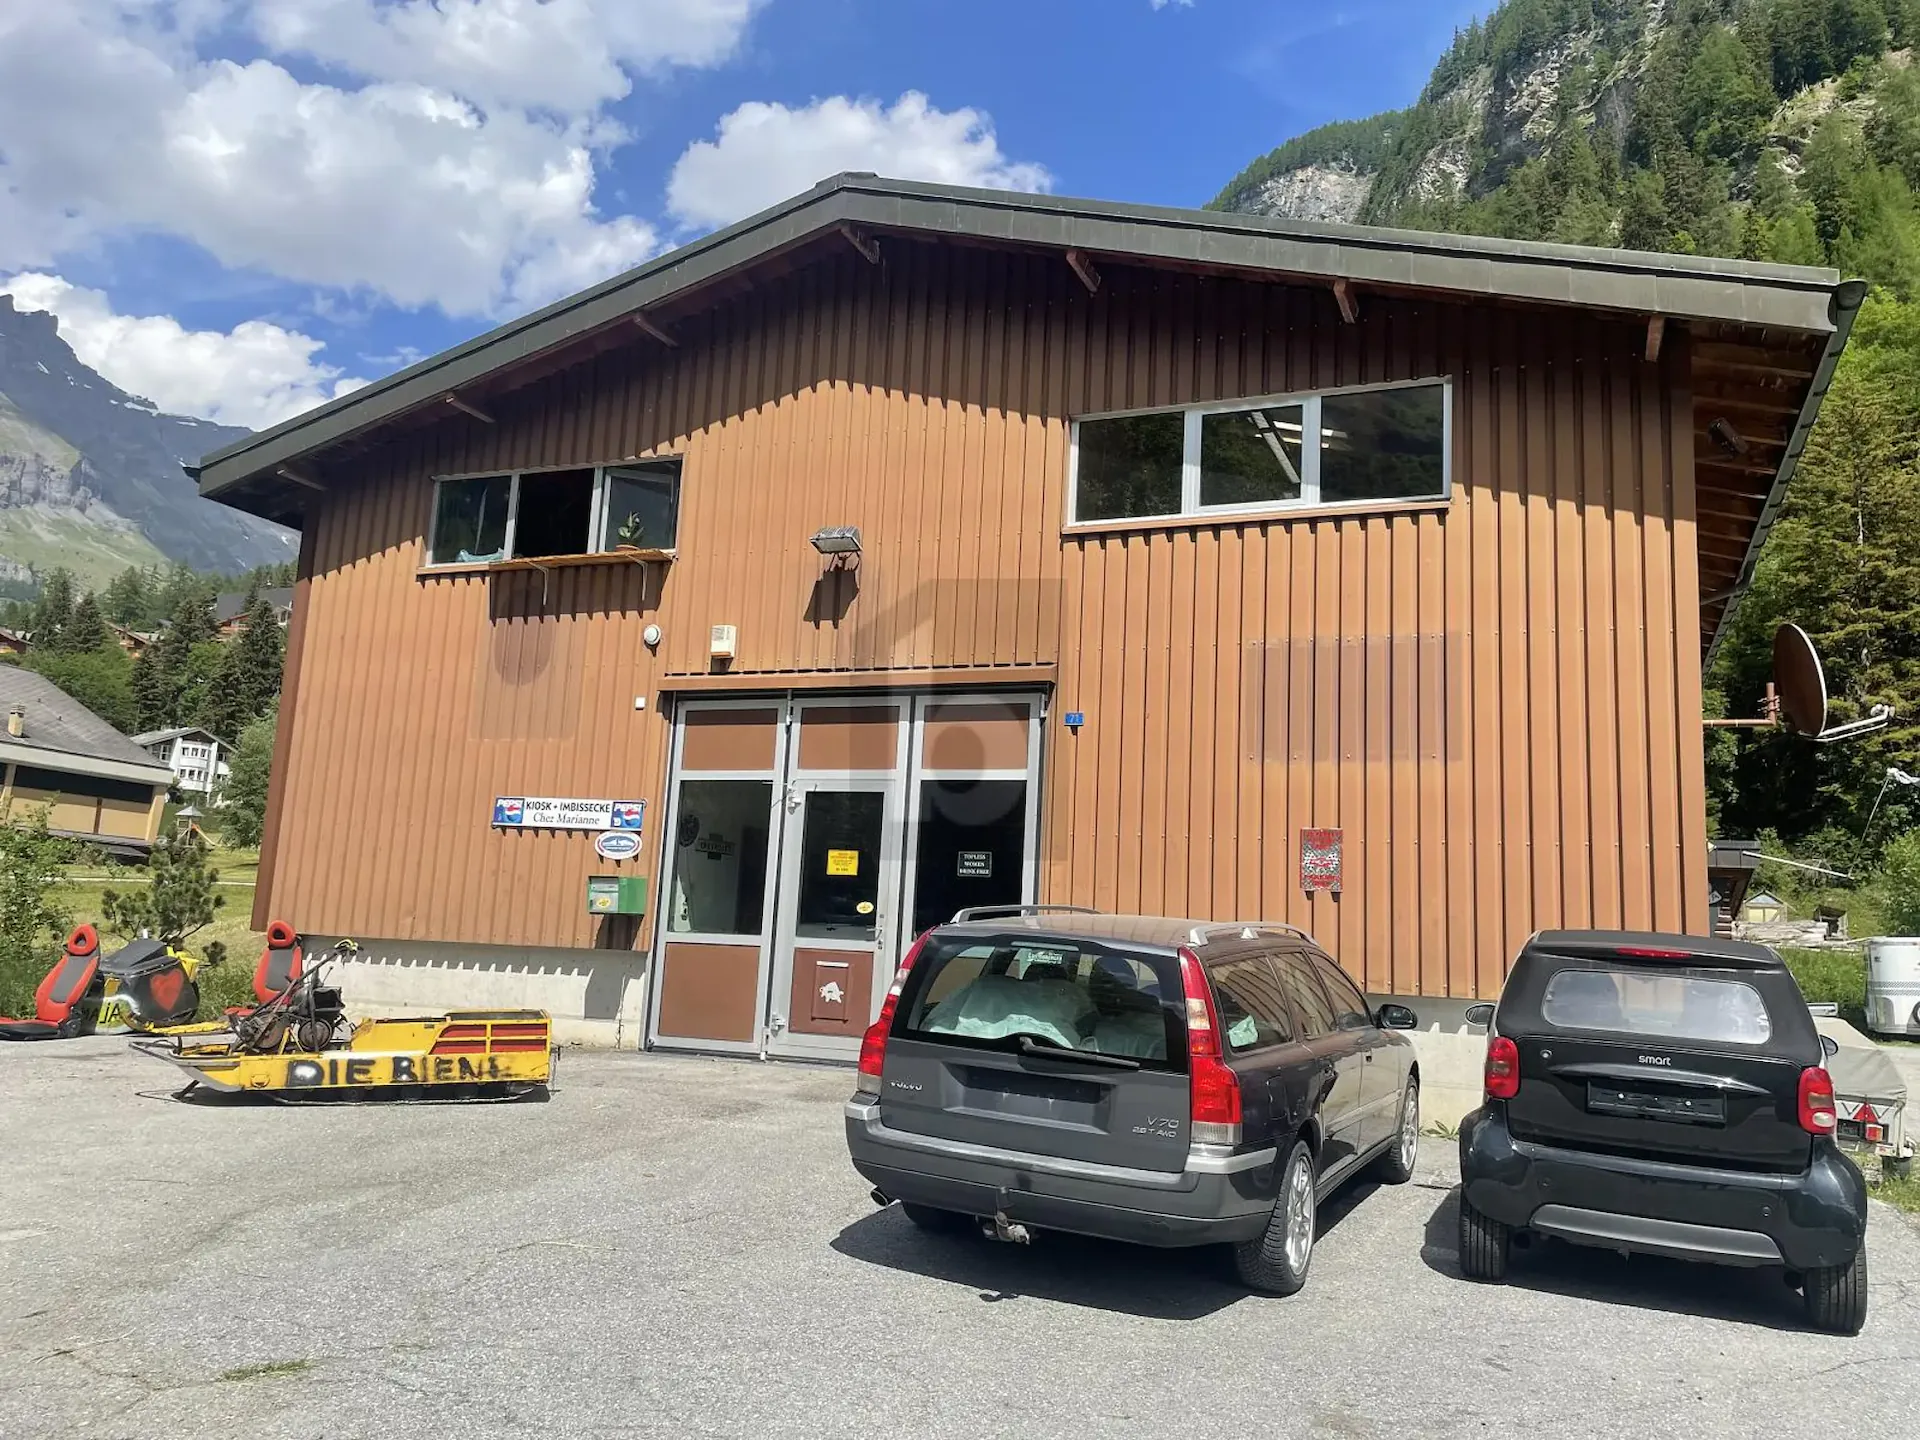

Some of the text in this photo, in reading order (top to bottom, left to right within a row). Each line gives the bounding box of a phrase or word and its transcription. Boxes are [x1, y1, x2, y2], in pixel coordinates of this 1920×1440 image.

[526, 801, 552, 811] KIOSK
[559, 802, 611, 813] IMBISSECKE
[533, 812, 600, 825] Chez Marianne
[1638, 1055, 1671, 1066] smart
[285, 1058, 381, 1088] DIE
